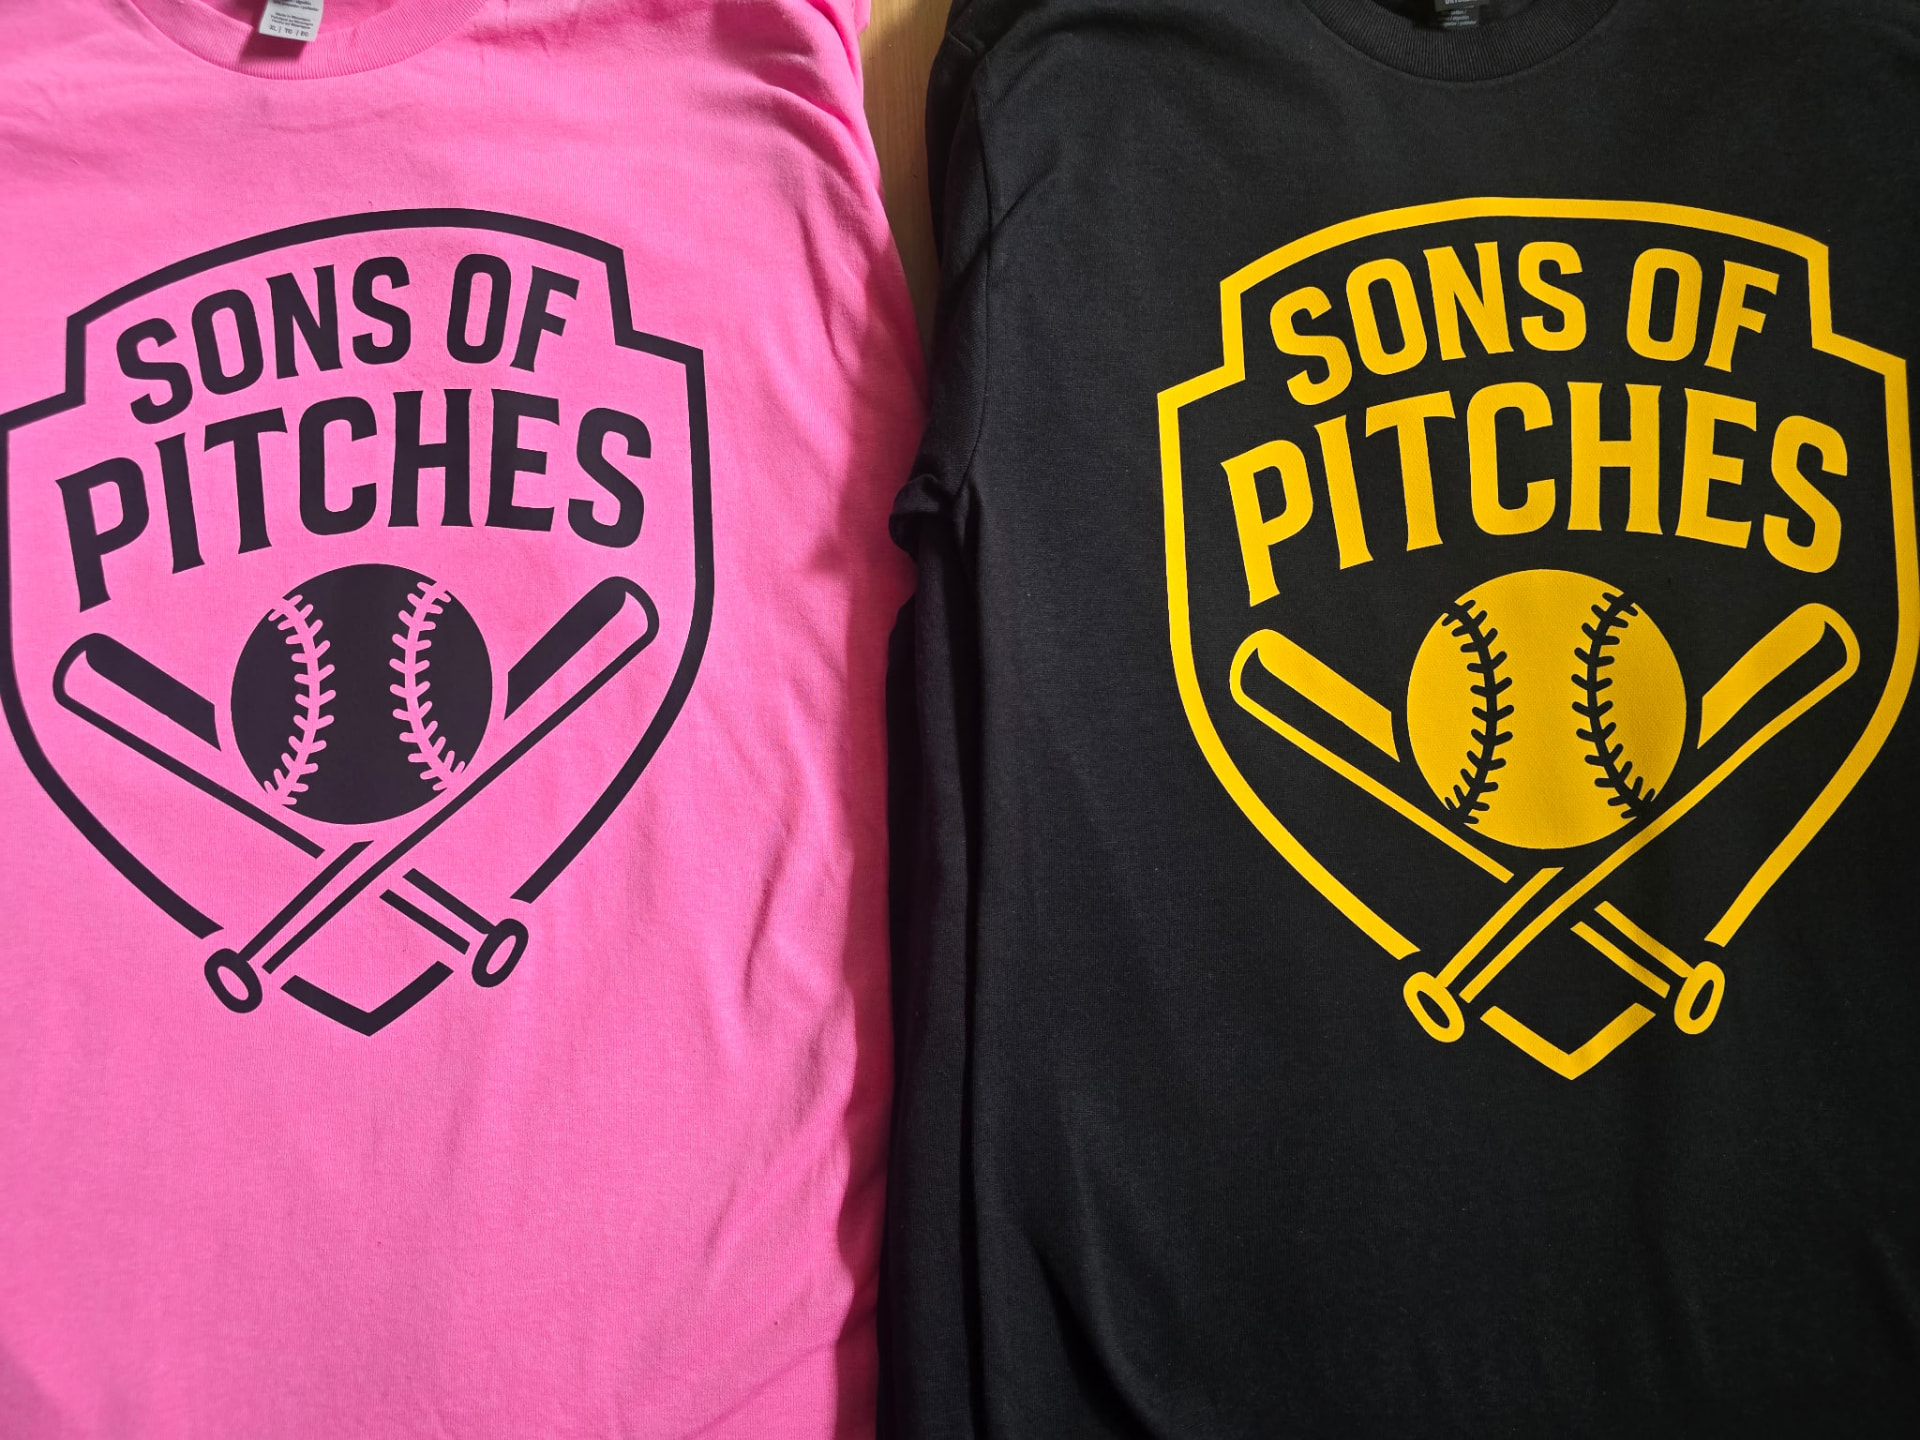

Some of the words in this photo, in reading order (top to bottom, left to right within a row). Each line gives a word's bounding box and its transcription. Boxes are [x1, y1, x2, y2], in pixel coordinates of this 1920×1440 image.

[117, 257, 410, 423] SONS
[447, 254, 579, 371] OF
[1270, 242, 1586, 405] SONS
[1627, 248, 1779, 372] OF
[56, 389, 651, 612] PITCHES
[1223, 382, 1847, 606] PITCHES
